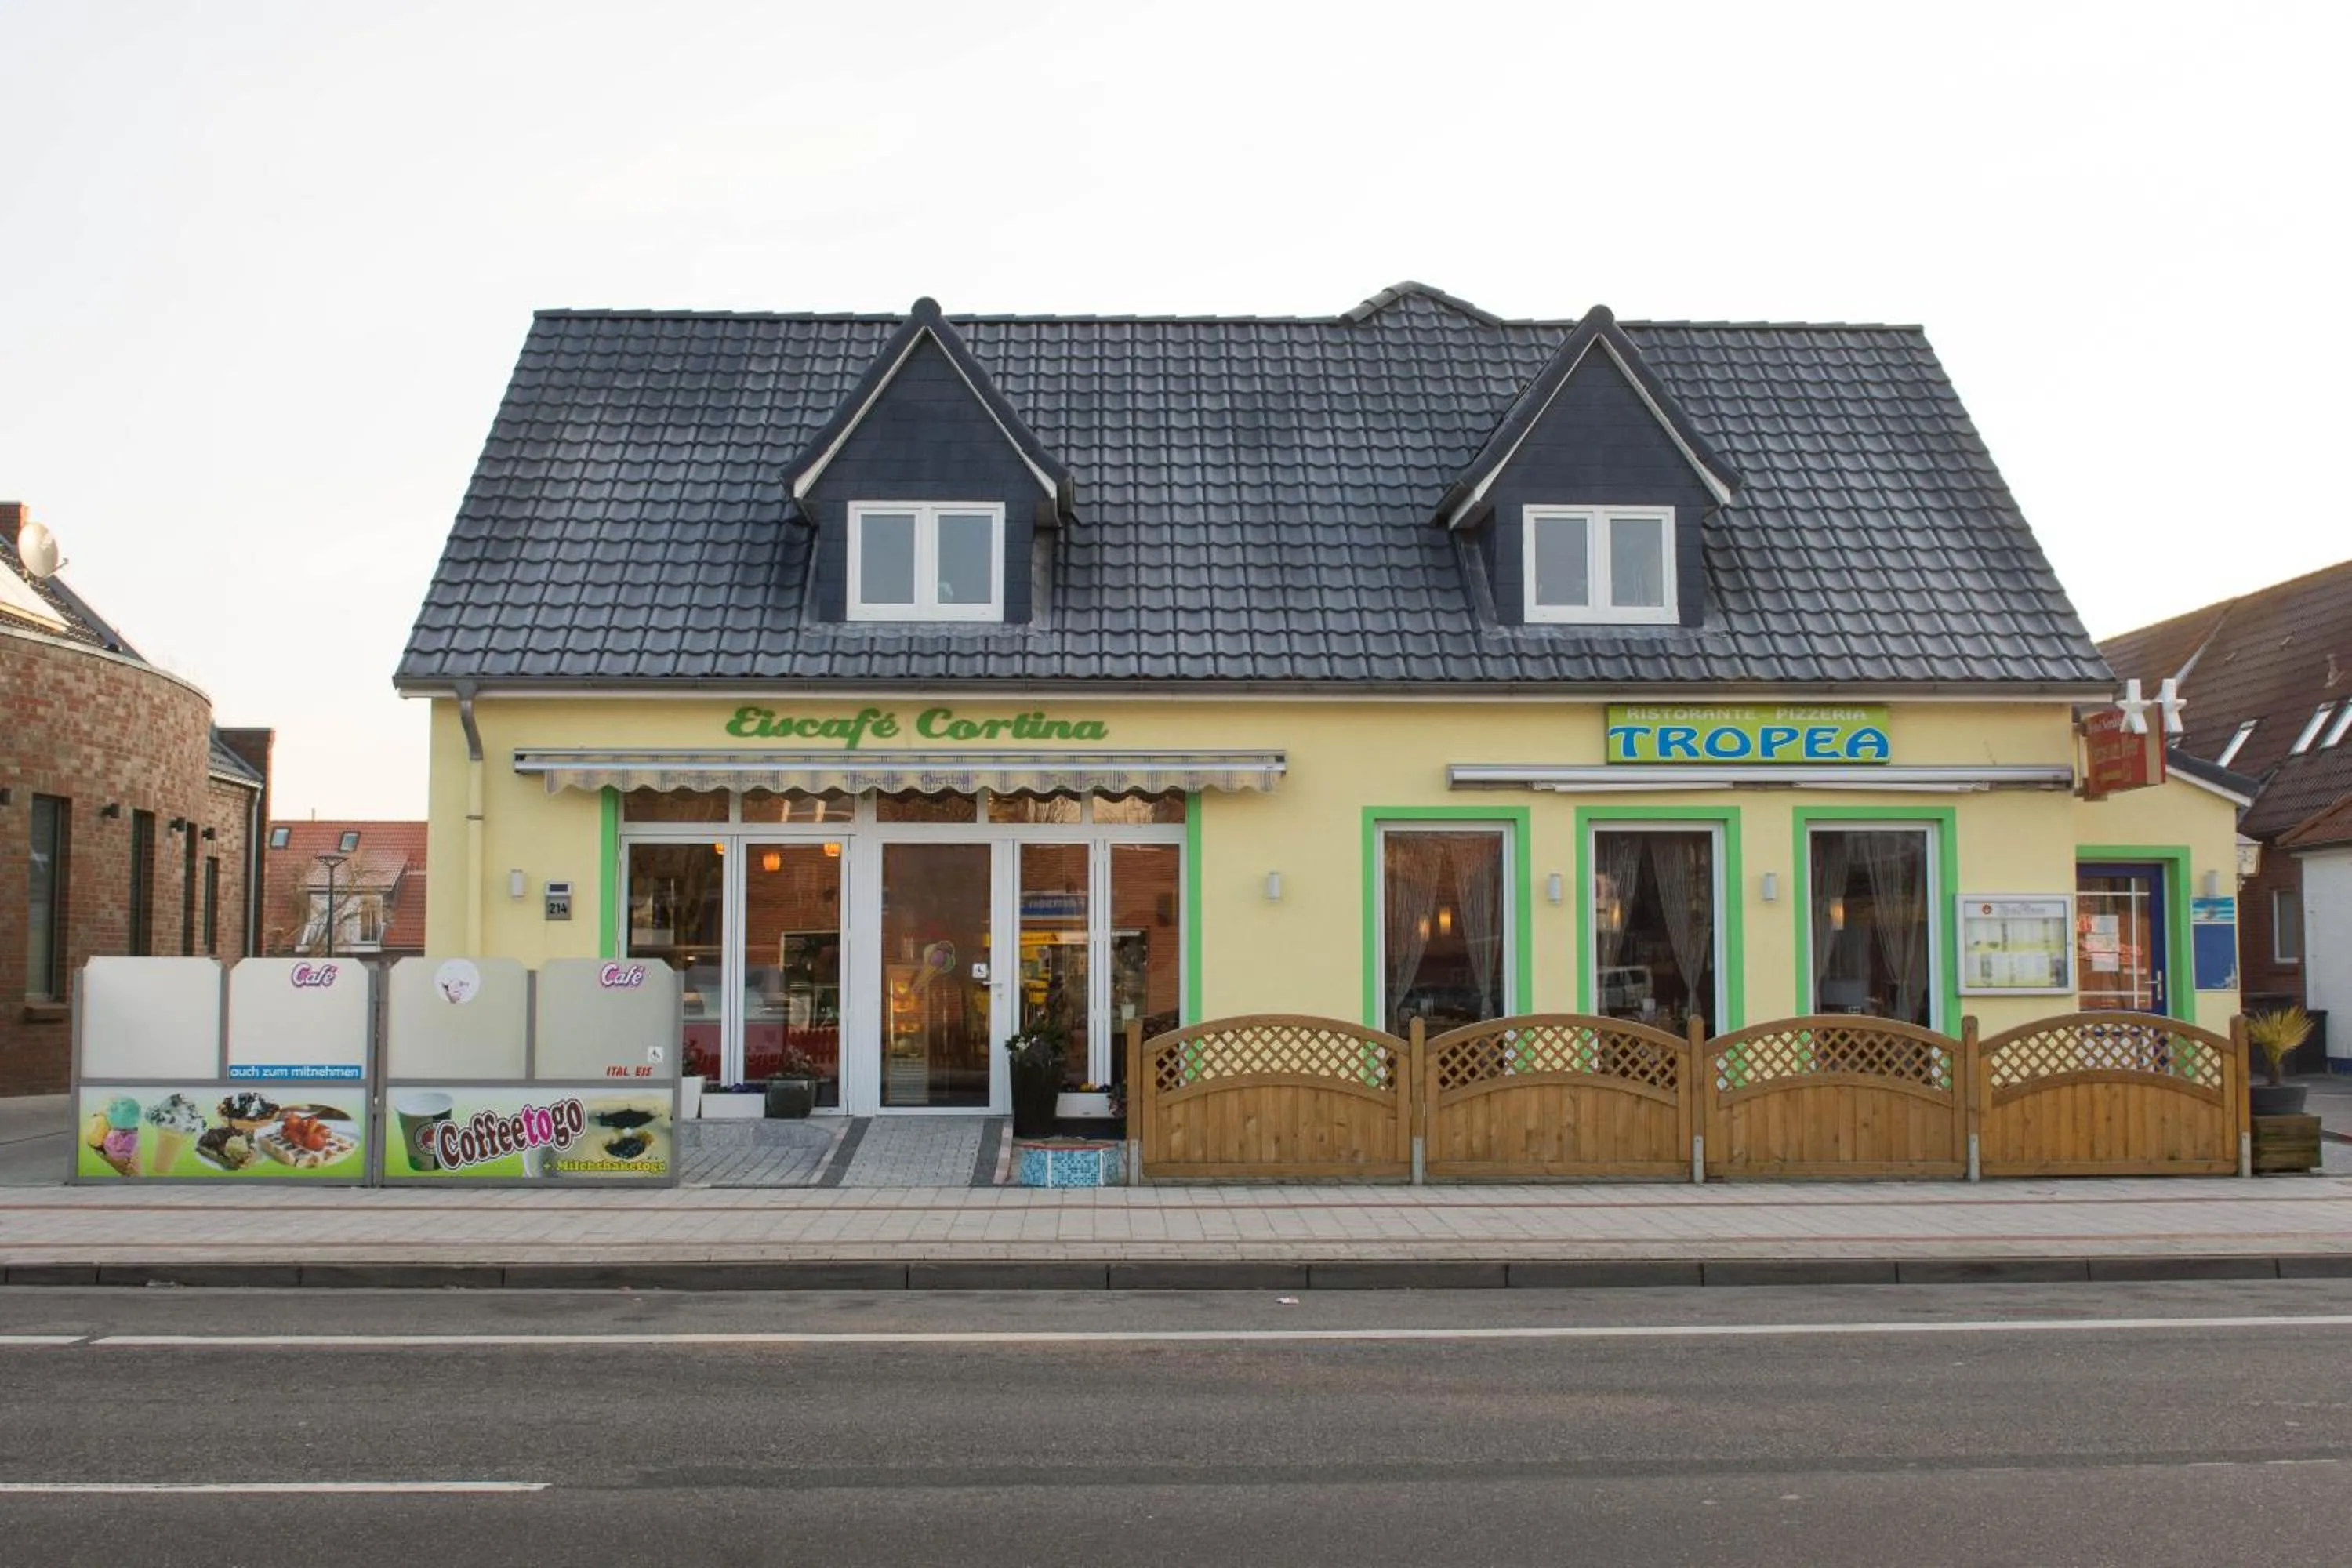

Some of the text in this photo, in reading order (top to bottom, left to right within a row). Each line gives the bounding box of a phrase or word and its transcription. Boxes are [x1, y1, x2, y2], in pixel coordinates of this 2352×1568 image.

[1626, 708, 1756, 720] RISTORANTE
[1776, 708, 1867, 720] PIZZERIA
[725, 706, 1109, 750] Eiscafé Cortina
[1608, 726, 1890, 759] TROPEA
[549, 903, 567, 914] 214
[292, 962, 338, 988] Café
[601, 963, 645, 987] Café
[230, 1066, 358, 1077] auch zum mitnehmen
[635, 1065, 653, 1076] EIS
